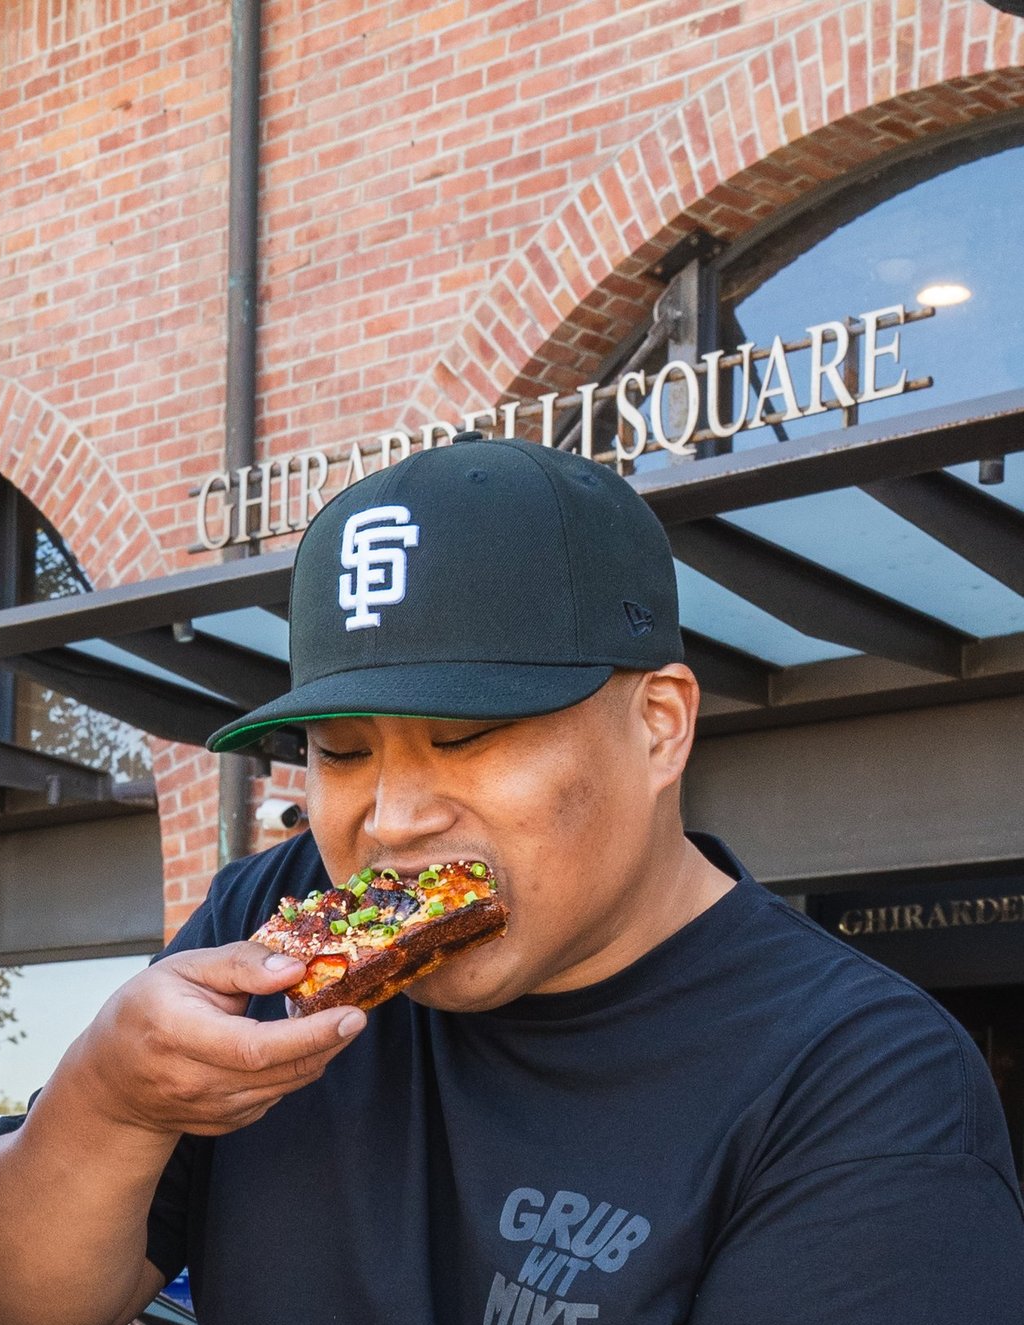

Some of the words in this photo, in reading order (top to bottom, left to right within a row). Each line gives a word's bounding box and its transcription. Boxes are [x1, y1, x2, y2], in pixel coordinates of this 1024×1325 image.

[616, 304, 908, 460] SQUARE
[338, 505, 420, 632] SF
[838, 894, 1024, 936] GHIRARDE
[498, 1187, 652, 1273] GRUB
[517, 1245, 592, 1298] WIT
